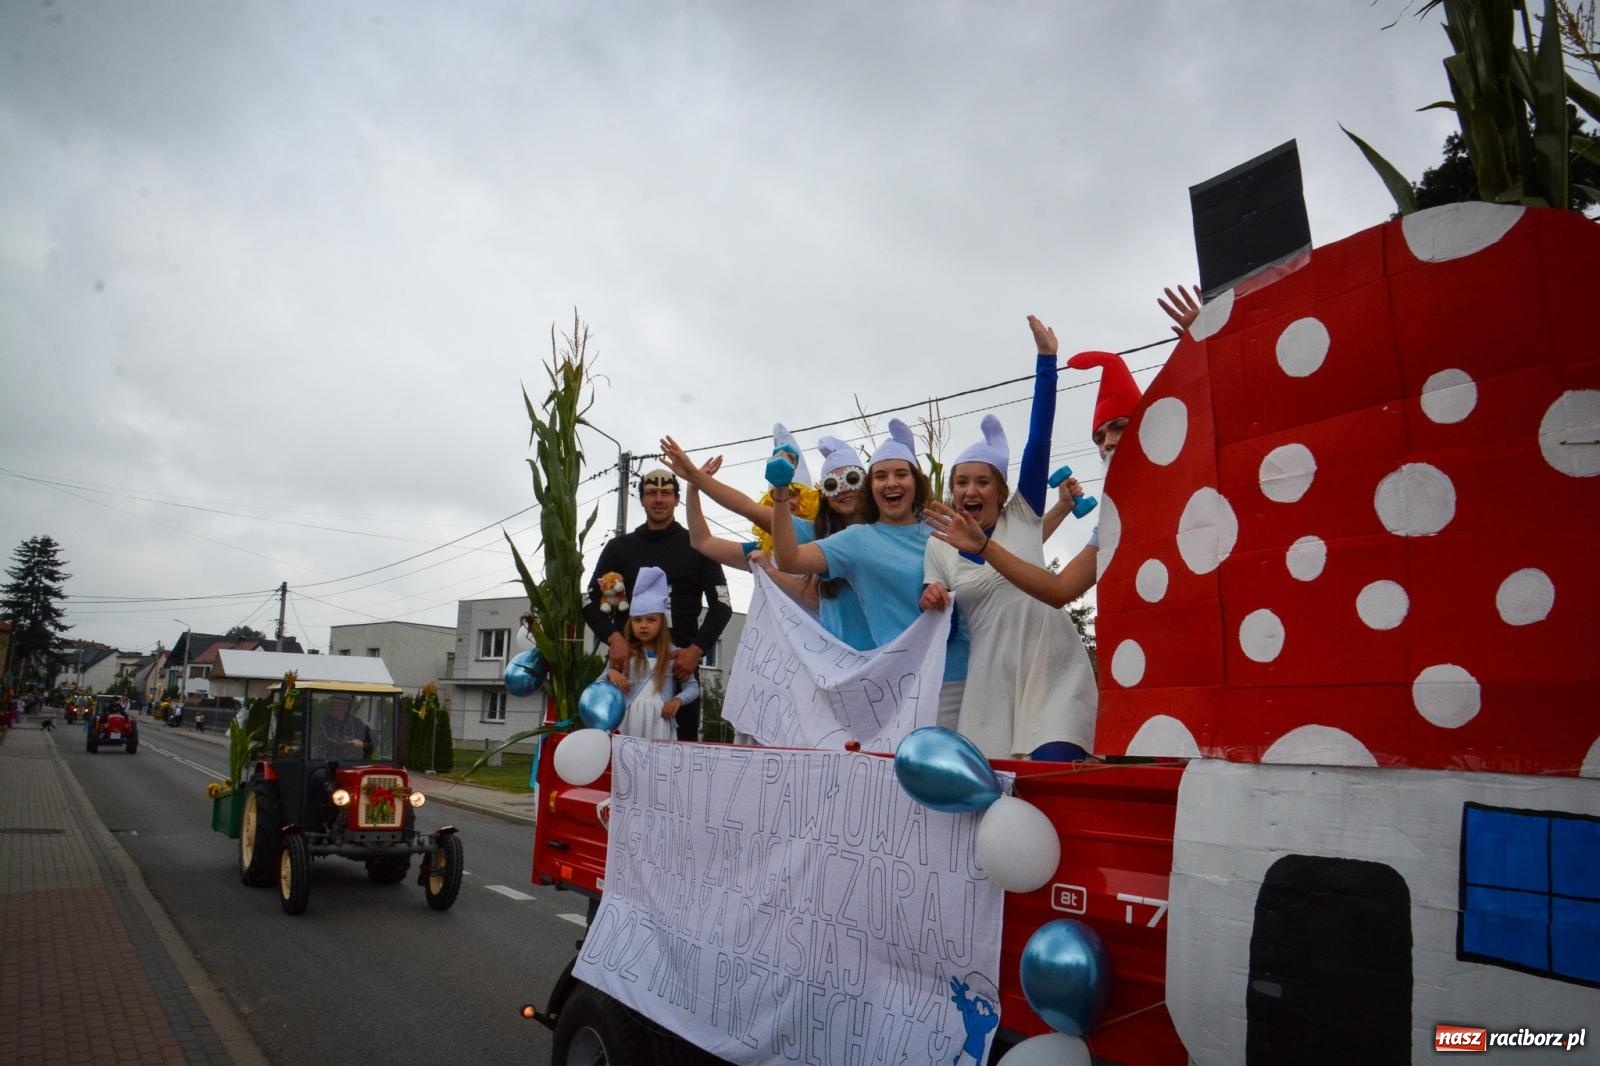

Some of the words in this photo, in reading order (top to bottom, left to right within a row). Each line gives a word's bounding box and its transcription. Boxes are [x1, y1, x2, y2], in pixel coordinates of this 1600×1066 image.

[616, 738, 720, 823] SMERFY
[723, 749, 753, 830] Z
[758, 752, 928, 865] PAWŁOWA
[615, 805, 696, 880] ZGRANA
[799, 842, 975, 967] WCZORAJ
[1060, 891, 1078, 907] 8t
[709, 892, 729, 948] A
[733, 896, 868, 997] DZISIAJ
[885, 943, 949, 1032] NA
